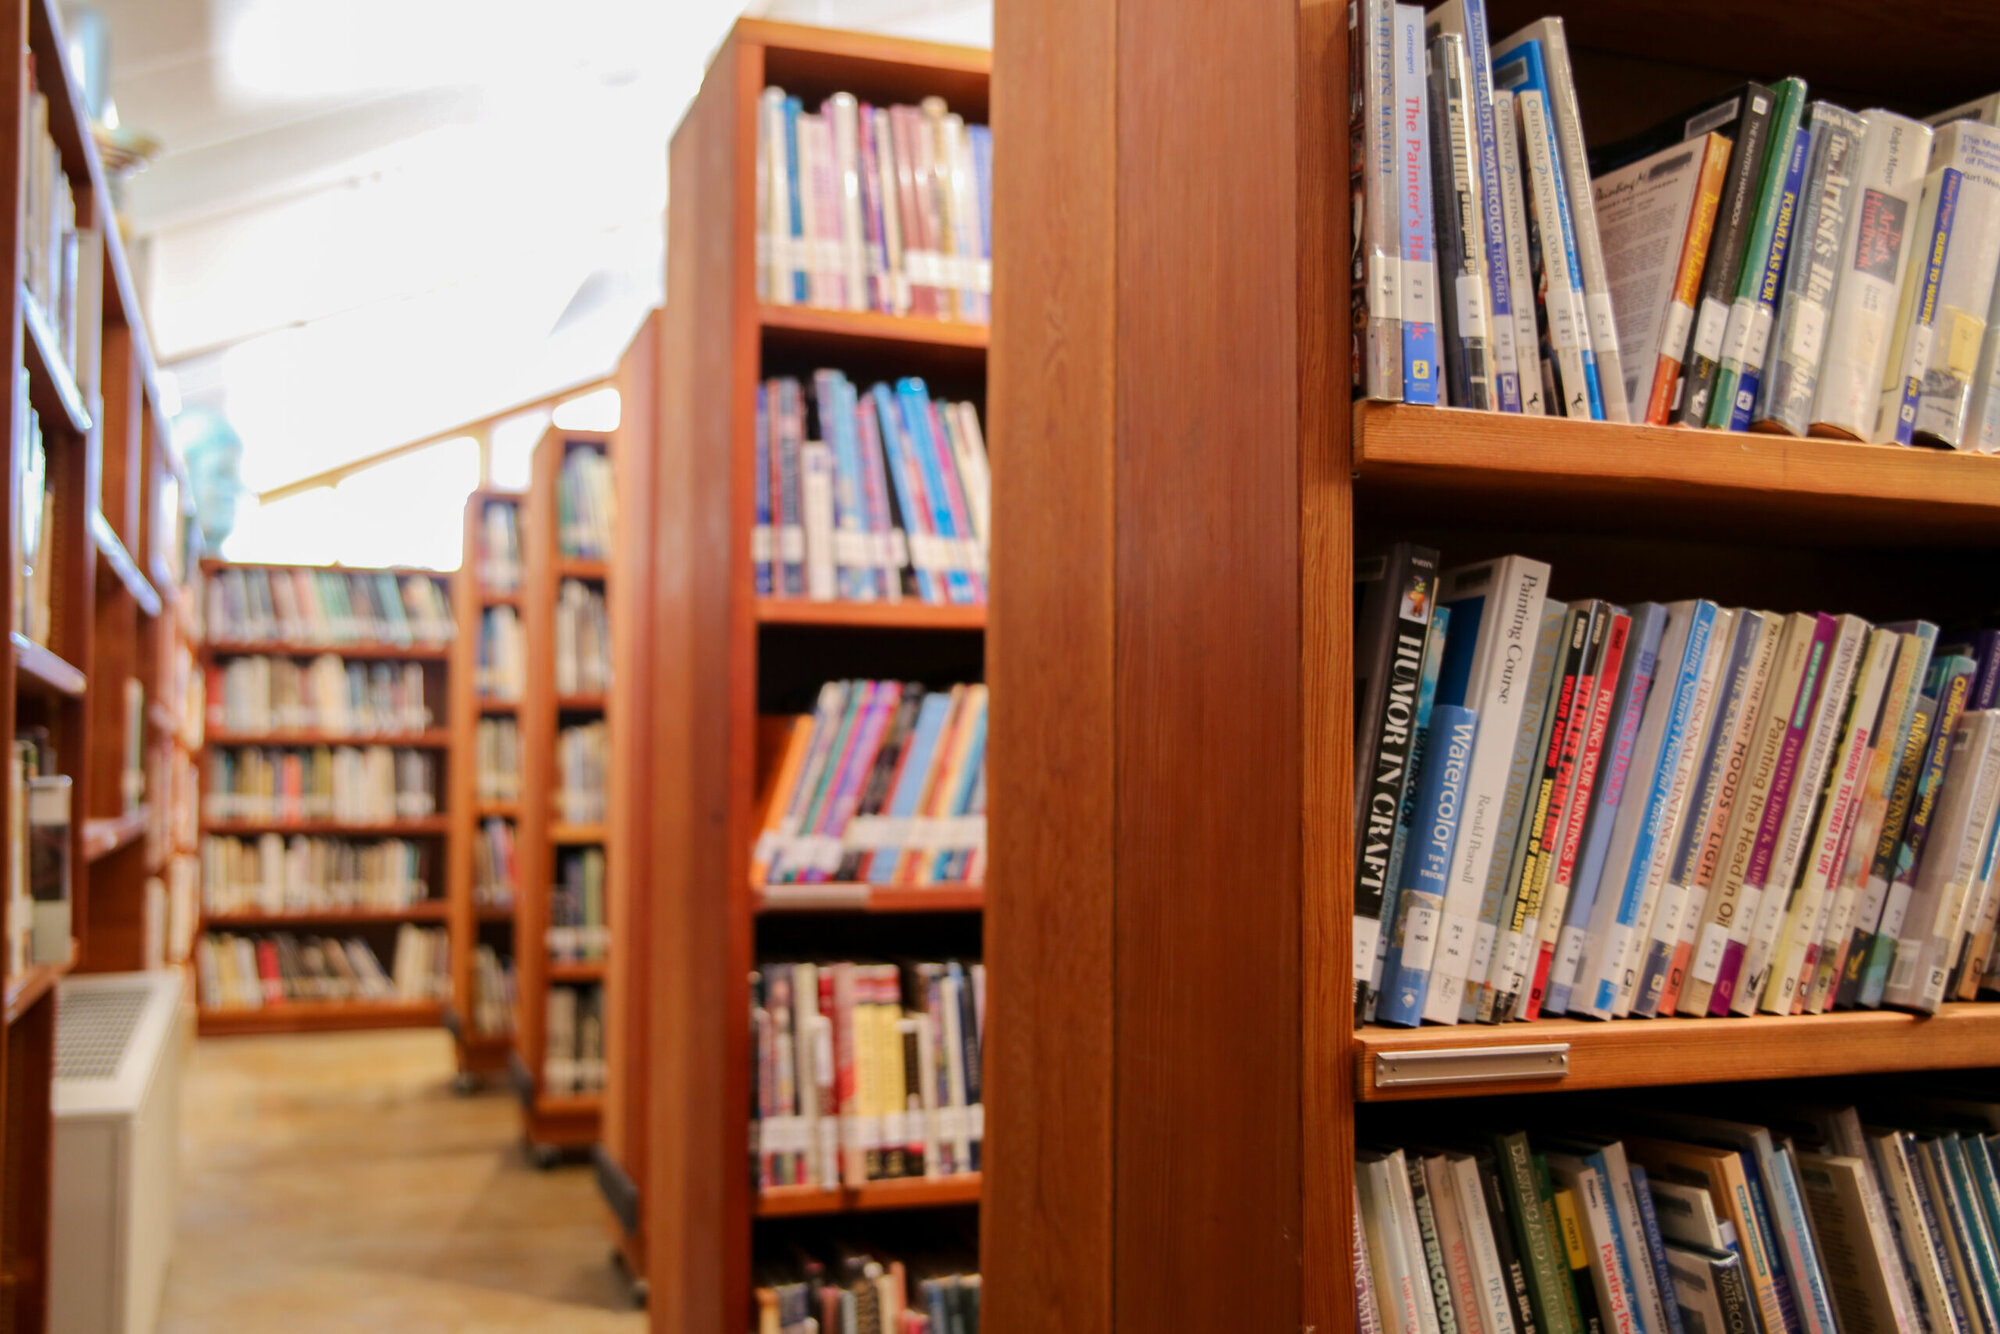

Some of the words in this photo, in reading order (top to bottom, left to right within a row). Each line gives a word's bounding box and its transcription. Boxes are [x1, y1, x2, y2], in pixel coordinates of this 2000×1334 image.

[1405, 24, 1415, 74] Gottsegen
[1472, 12, 1485, 68] PAINTING
[1405, 96, 1420, 131] The
[1478, 71, 1493, 142] REALISTIC
[1498, 99, 1513, 162] ORIENTAL
[1527, 99, 1544, 162] ORIENTAL
[1748, 121, 1758, 136] THE
[1377, 105, 1393, 177] MANUAL
[1829, 133, 1847, 161] The
[1886, 125, 1902, 154] Ralph
[1406, 138, 1422, 228] Painter's
[1483, 146, 1503, 244] WATERCOLOR
[1503, 164, 1521, 229] PAINTING
[1534, 165, 1554, 230] PAINTING
[1881, 155, 1897, 186] Mayer
[1459, 202, 1475, 257] complete
[1768, 191, 1794, 270] FORMULAS
[1813, 163, 1848, 258] Artist's
[1855, 190, 1883, 270] Handbook
[1873, 207, 1896, 263] Artist's
[1511, 234, 1525, 281] COURSE
[1547, 235, 1562, 281] COURSE
[1928, 267, 1939, 282] TO
[1932, 231, 1946, 265] GUIDE
[1493, 248, 1506, 304] TEXTURES
[1761, 270, 1777, 300] FOR
[1507, 573, 1537, 640] Painting
[1496, 643, 1523, 705] Course
[1683, 619, 1710, 675] Painting
[1756, 622, 1778, 677] PAINTING
[1831, 635, 1856, 694] PAINTING
[1381, 634, 1421, 746] HUMOR
[1556, 674, 1574, 719] WILDLIFE
[1621, 674, 1649, 738] PAINTING
[1672, 677, 1696, 732] Nature's
[1731, 665, 1748, 695] THE
[1750, 679, 1762, 702] THE
[1940, 675, 1967, 736] Children
[1561, 674, 1592, 758] WILDLIFE
[1587, 689, 1611, 750] PULLING
[1679, 678, 1710, 764] PERSONAL
[1711, 697, 1739, 770] SEASCAPE
[1740, 704, 1756, 738] MANY
[1899, 711, 1929, 775] PAINTING
[1376, 751, 1403, 786] IN
[1546, 720, 1564, 768] PAINTING
[1578, 751, 1596, 787] YOUR
[1655, 733, 1682, 791] Peaceful
[1751, 715, 1787, 790] Painting
[1775, 737, 1797, 792] PAINTING
[1843, 727, 1869, 781] BRINGING
[1932, 736, 1950, 766] and
[1399, 726, 1428, 828] WATERCOLOR
[1429, 721, 1472, 851] Watercolor
[1604, 753, 1630, 807] DESIGN
[1718, 741, 1747, 809] MOODS
[1800, 782, 1814, 803] OF
[1913, 766, 1942, 826] Painting
[1471, 794, 1491, 837] Ronald
[1531, 778, 1553, 838] TECHNIQUES
[1539, 761, 1572, 851] PAINTING
[1561, 789, 1587, 860] PAINTINGS
[1647, 793, 1666, 835] Places
[1658, 768, 1687, 847] PAINTING
[1744, 793, 1765, 824] the
[1764, 795, 1782, 829] LIGHT
[1827, 783, 1852, 834] TEXTURES
[1876, 775, 1910, 857] TECHNIQUES
[1358, 790, 1396, 895] CRAFT
[1429, 854, 1444, 864] TIPS
[1460, 838, 1481, 884] Pearsall
[1528, 839, 1539, 853] OF
[1729, 827, 1755, 877] Head
[1762, 833, 1771, 843] &
[1815, 853, 1831, 875] LIFE
[1822, 836, 1836, 852] TO
[1420, 869, 1444, 881] TRICKS
[1518, 855, 1536, 899] MODERN
[1723, 880, 1740, 898] in
[1511, 901, 1527, 933] MAST
[1714, 901, 1734, 928] Oil
[1509, 1141, 1539, 1221] DRAWING
[1527, 1220, 1548, 1261] AND
[1621, 1181, 1640, 1226] painting
[1905, 1152, 1930, 1203] Painting
[1935, 1244, 1953, 1279] White
[1600, 1243, 1626, 1312] Painting
[1637, 1179, 1664, 1262] WATERCOLOR
[1656, 1262, 1679, 1322] PAINTING
[1451, 1239, 1480, 1333] WATERCOLO
[1488, 1277, 1504, 1307] PEN
[1496, 1310, 1507, 1323] &
[1509, 1259, 1525, 1292] THE
[1517, 1294, 1532, 1322] BIG
